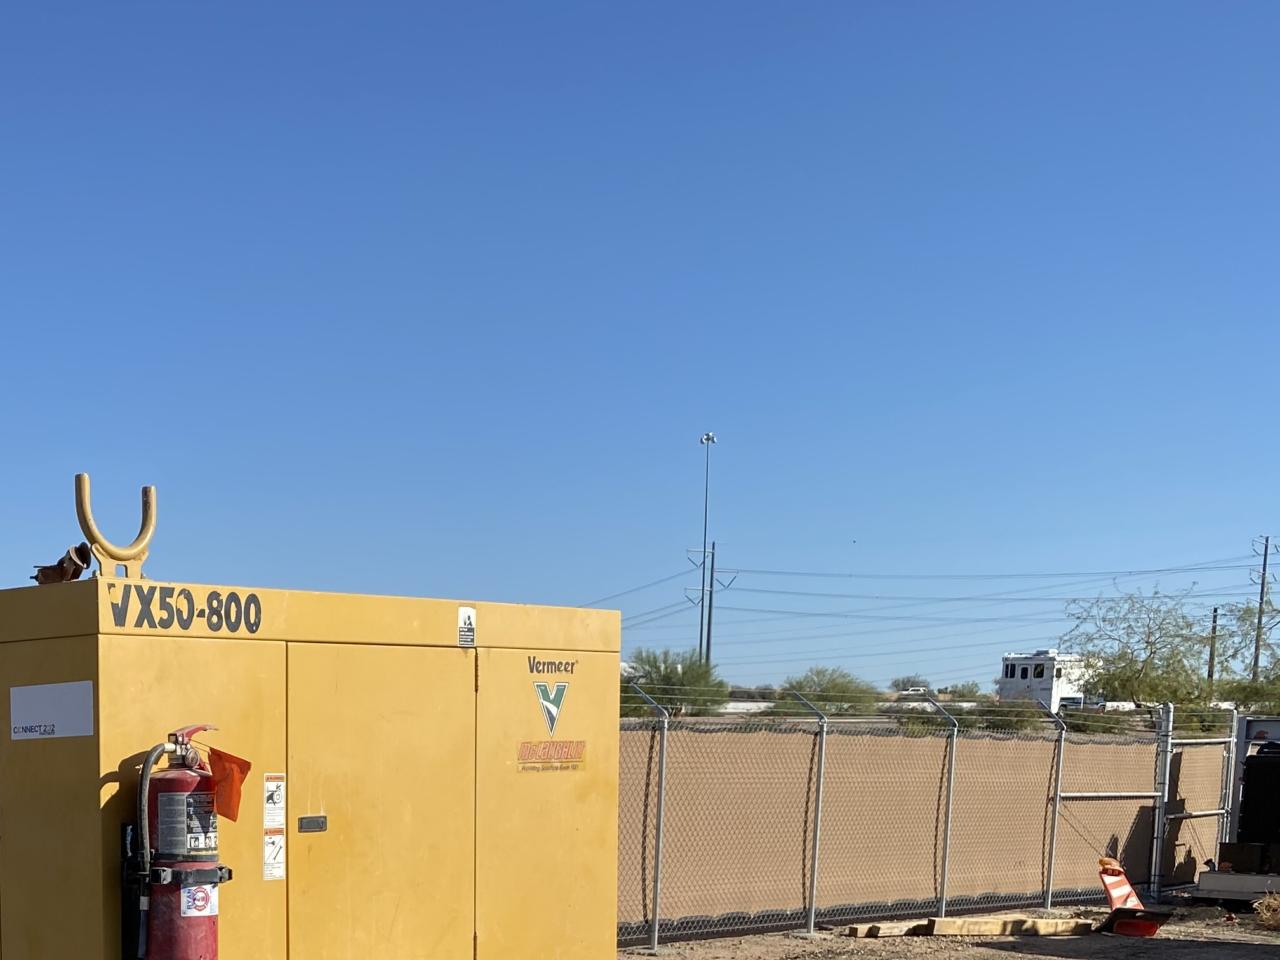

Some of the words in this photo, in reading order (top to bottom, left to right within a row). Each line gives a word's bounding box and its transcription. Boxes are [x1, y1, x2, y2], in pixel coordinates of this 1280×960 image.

[106, 582, 262, 634] VX50-800
[527, 655, 575, 675] Vermeer
[43, 723, 56, 732] 22
